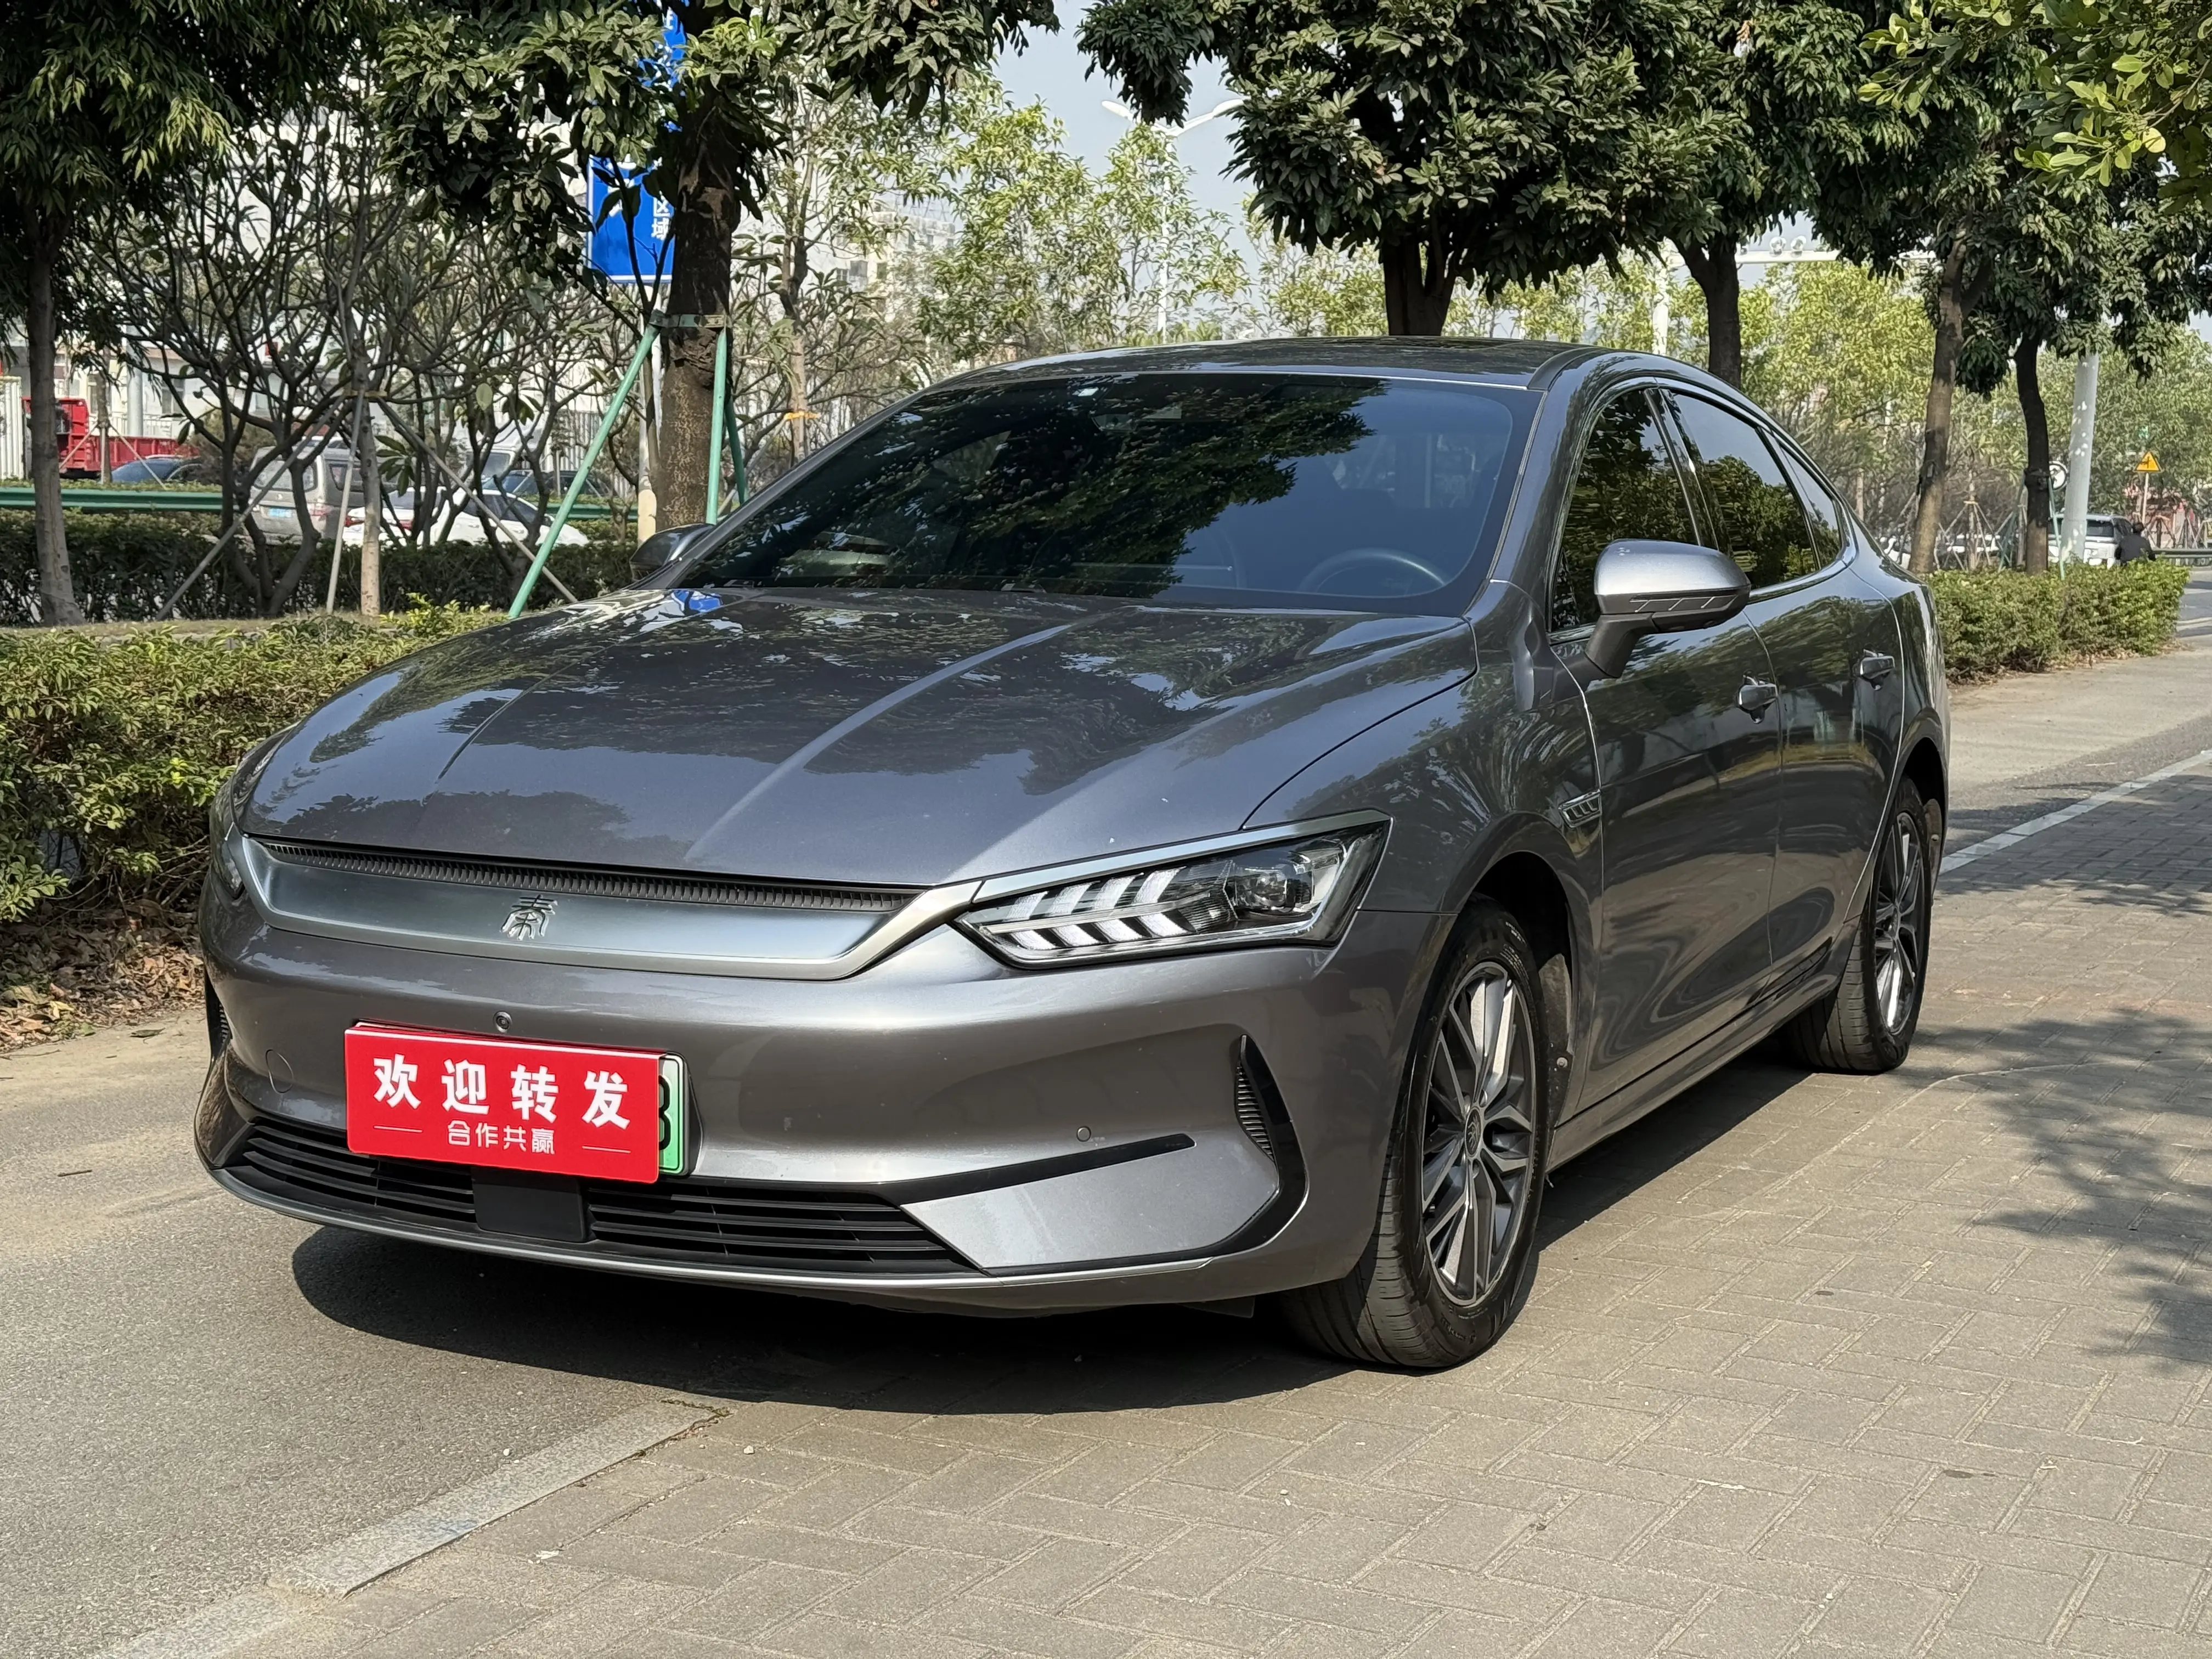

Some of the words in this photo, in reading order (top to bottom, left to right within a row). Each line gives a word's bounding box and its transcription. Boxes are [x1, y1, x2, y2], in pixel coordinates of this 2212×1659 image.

[374, 1053, 631, 1130] 欢迎转发
[448, 1120, 555, 1155] 合作共赢
